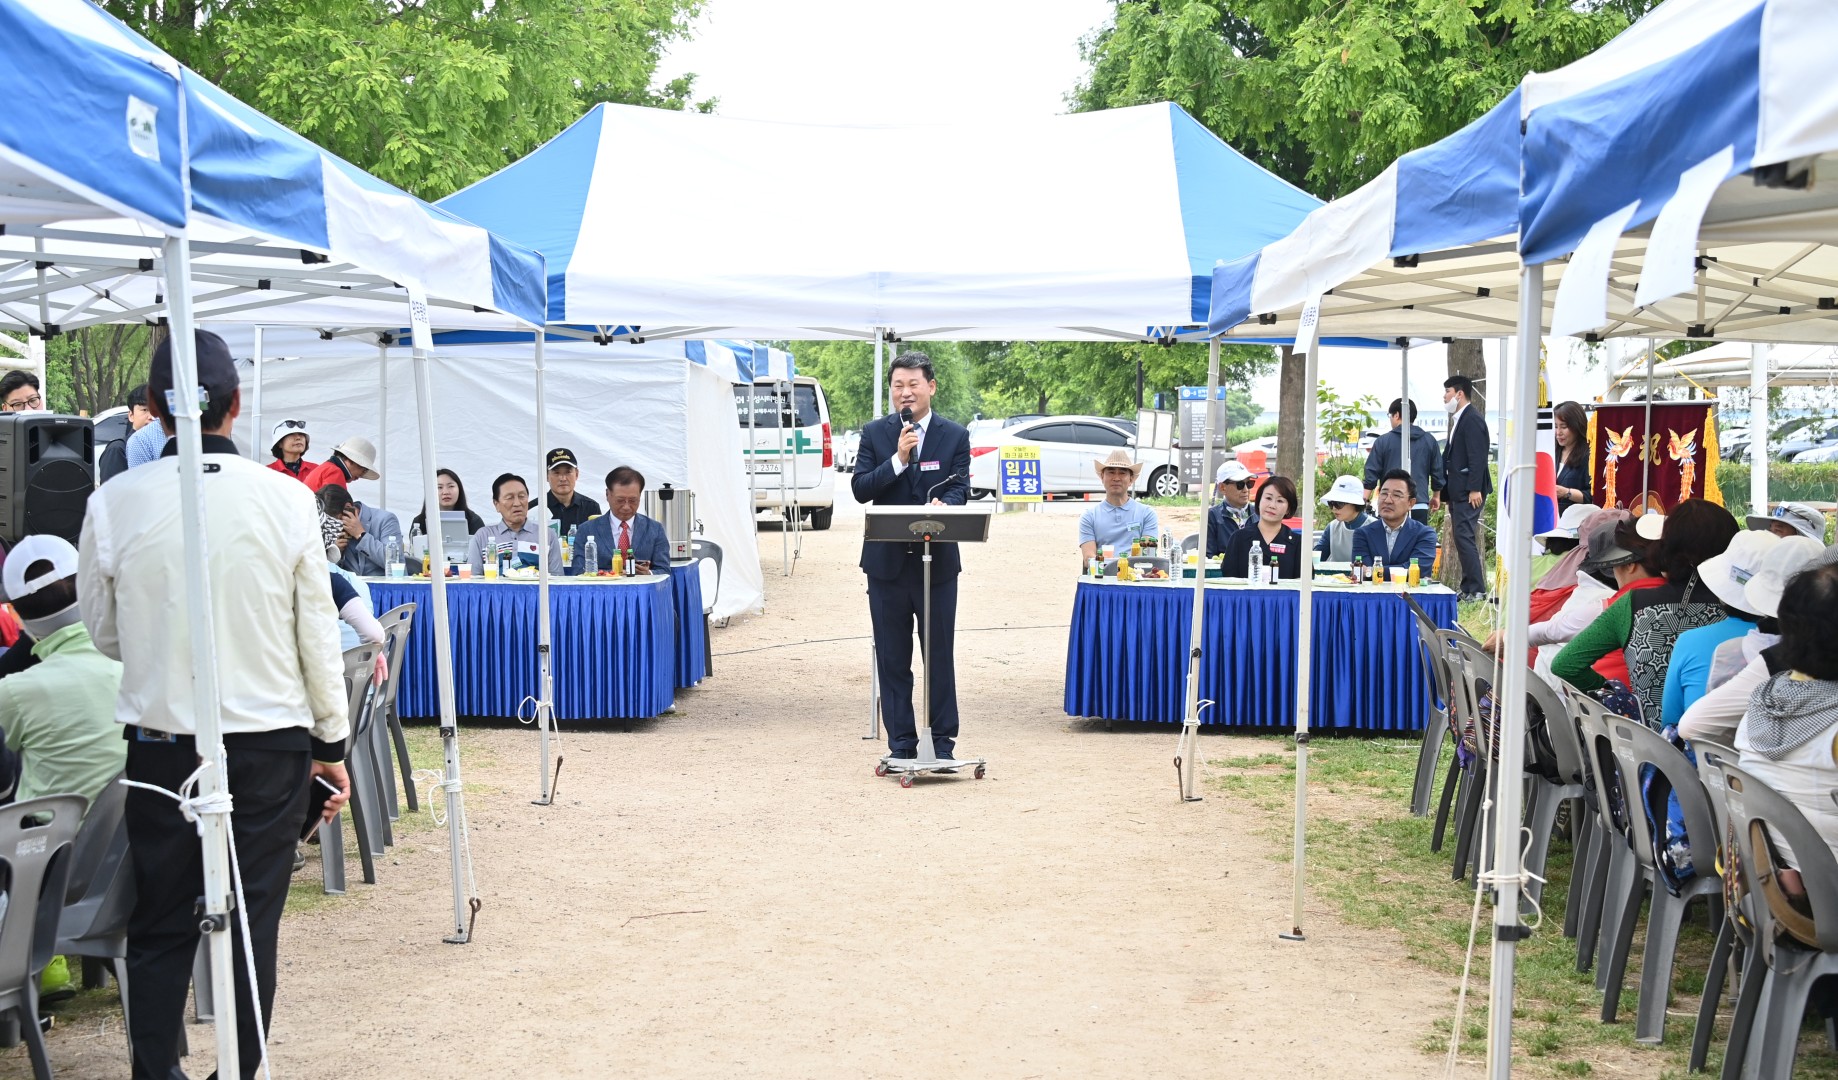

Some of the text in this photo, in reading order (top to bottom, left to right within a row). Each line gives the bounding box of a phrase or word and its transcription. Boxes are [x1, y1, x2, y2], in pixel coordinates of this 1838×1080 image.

[760, 464, 779, 472] 2376
[1005, 461, 1037, 476] 임시
[1006, 478, 1039, 493] 휴장
